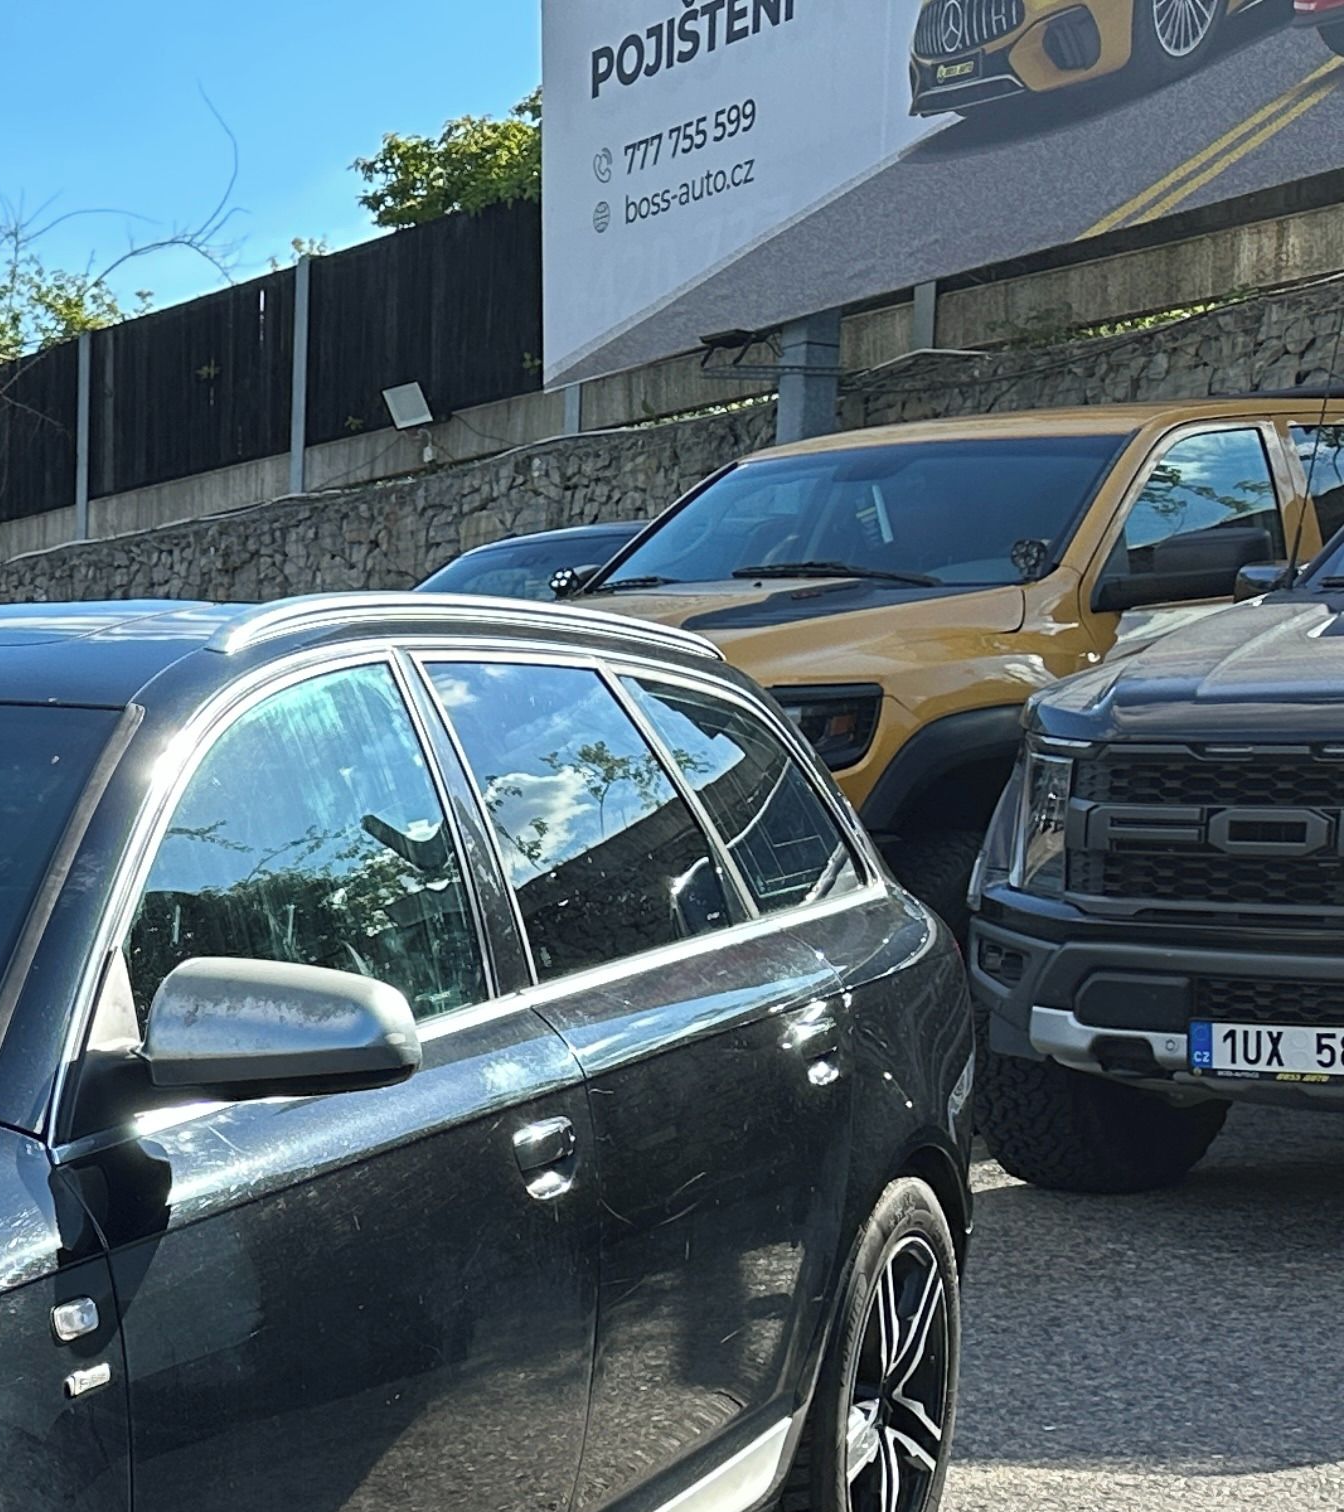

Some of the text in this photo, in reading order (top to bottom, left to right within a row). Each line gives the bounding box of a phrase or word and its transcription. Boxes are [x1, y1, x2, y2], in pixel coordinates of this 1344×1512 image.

[623, 99, 756, 175] 777 755 599
[624, 159, 755, 224] boss-auto.cz
[1193, 1029, 1344, 1068] CZ 1UX 5
